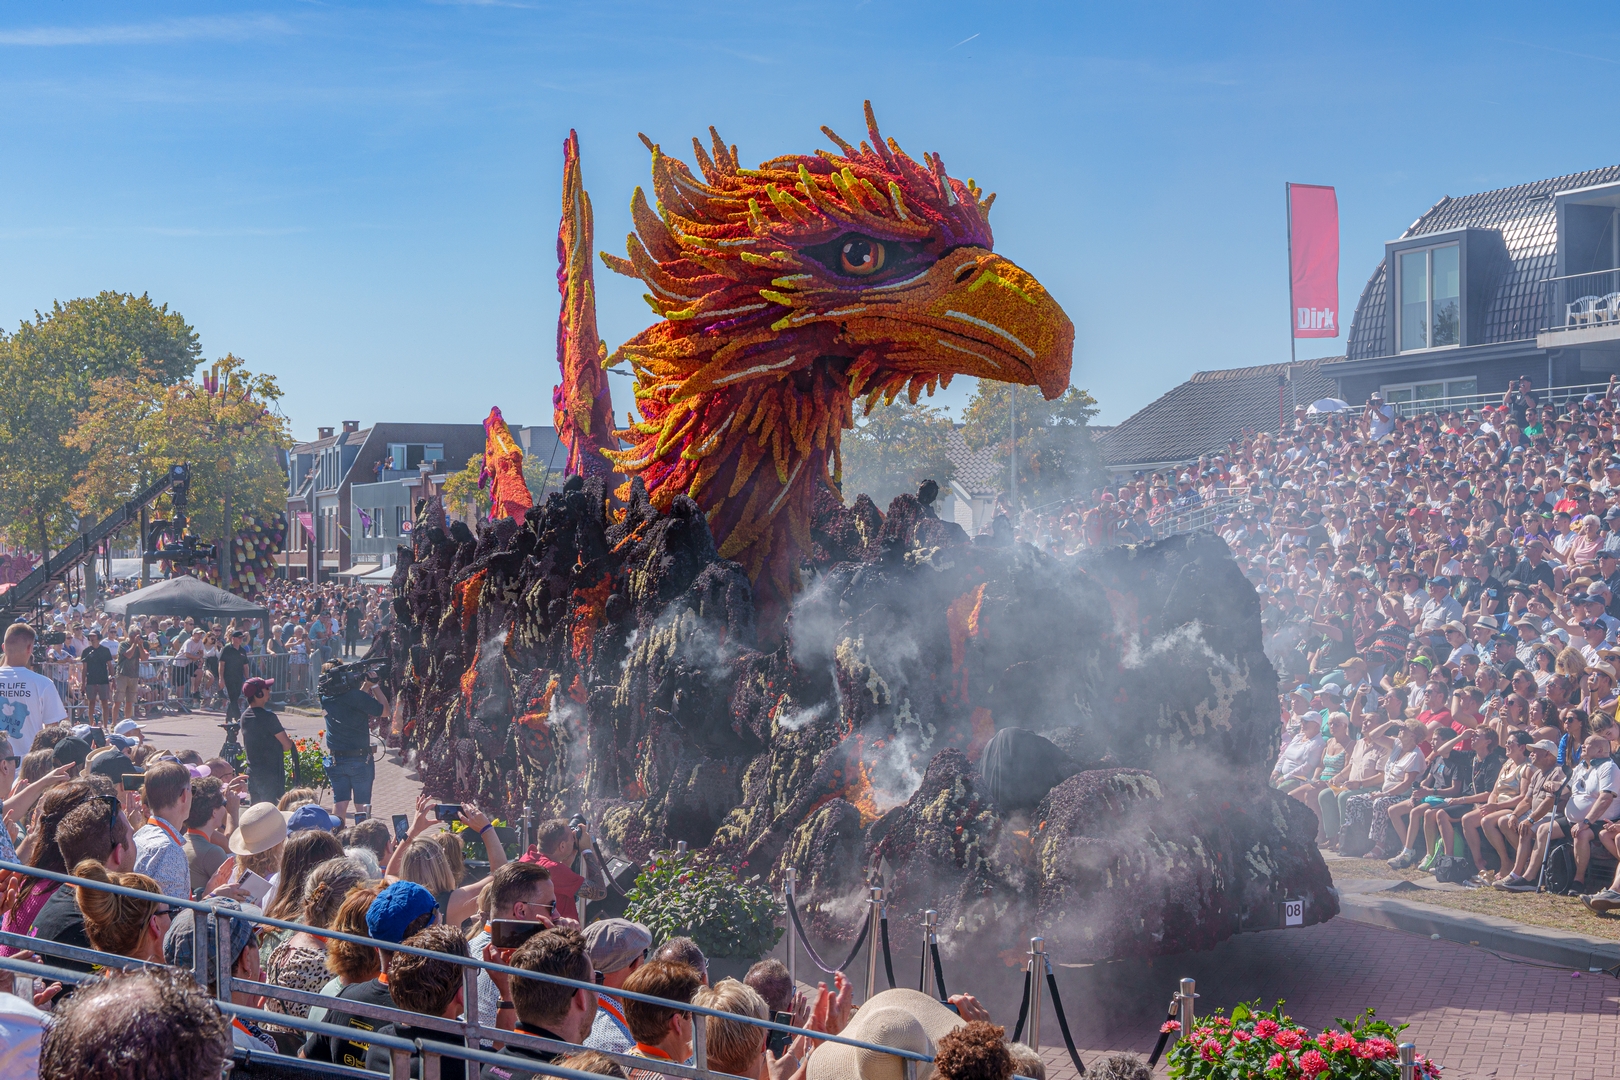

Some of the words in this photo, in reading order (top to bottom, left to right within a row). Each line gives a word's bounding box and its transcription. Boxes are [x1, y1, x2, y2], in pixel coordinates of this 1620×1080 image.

[1297, 307, 1335, 329] Dirk
[7, 682, 27, 690] LIFE
[1287, 904, 1301, 917] 08
